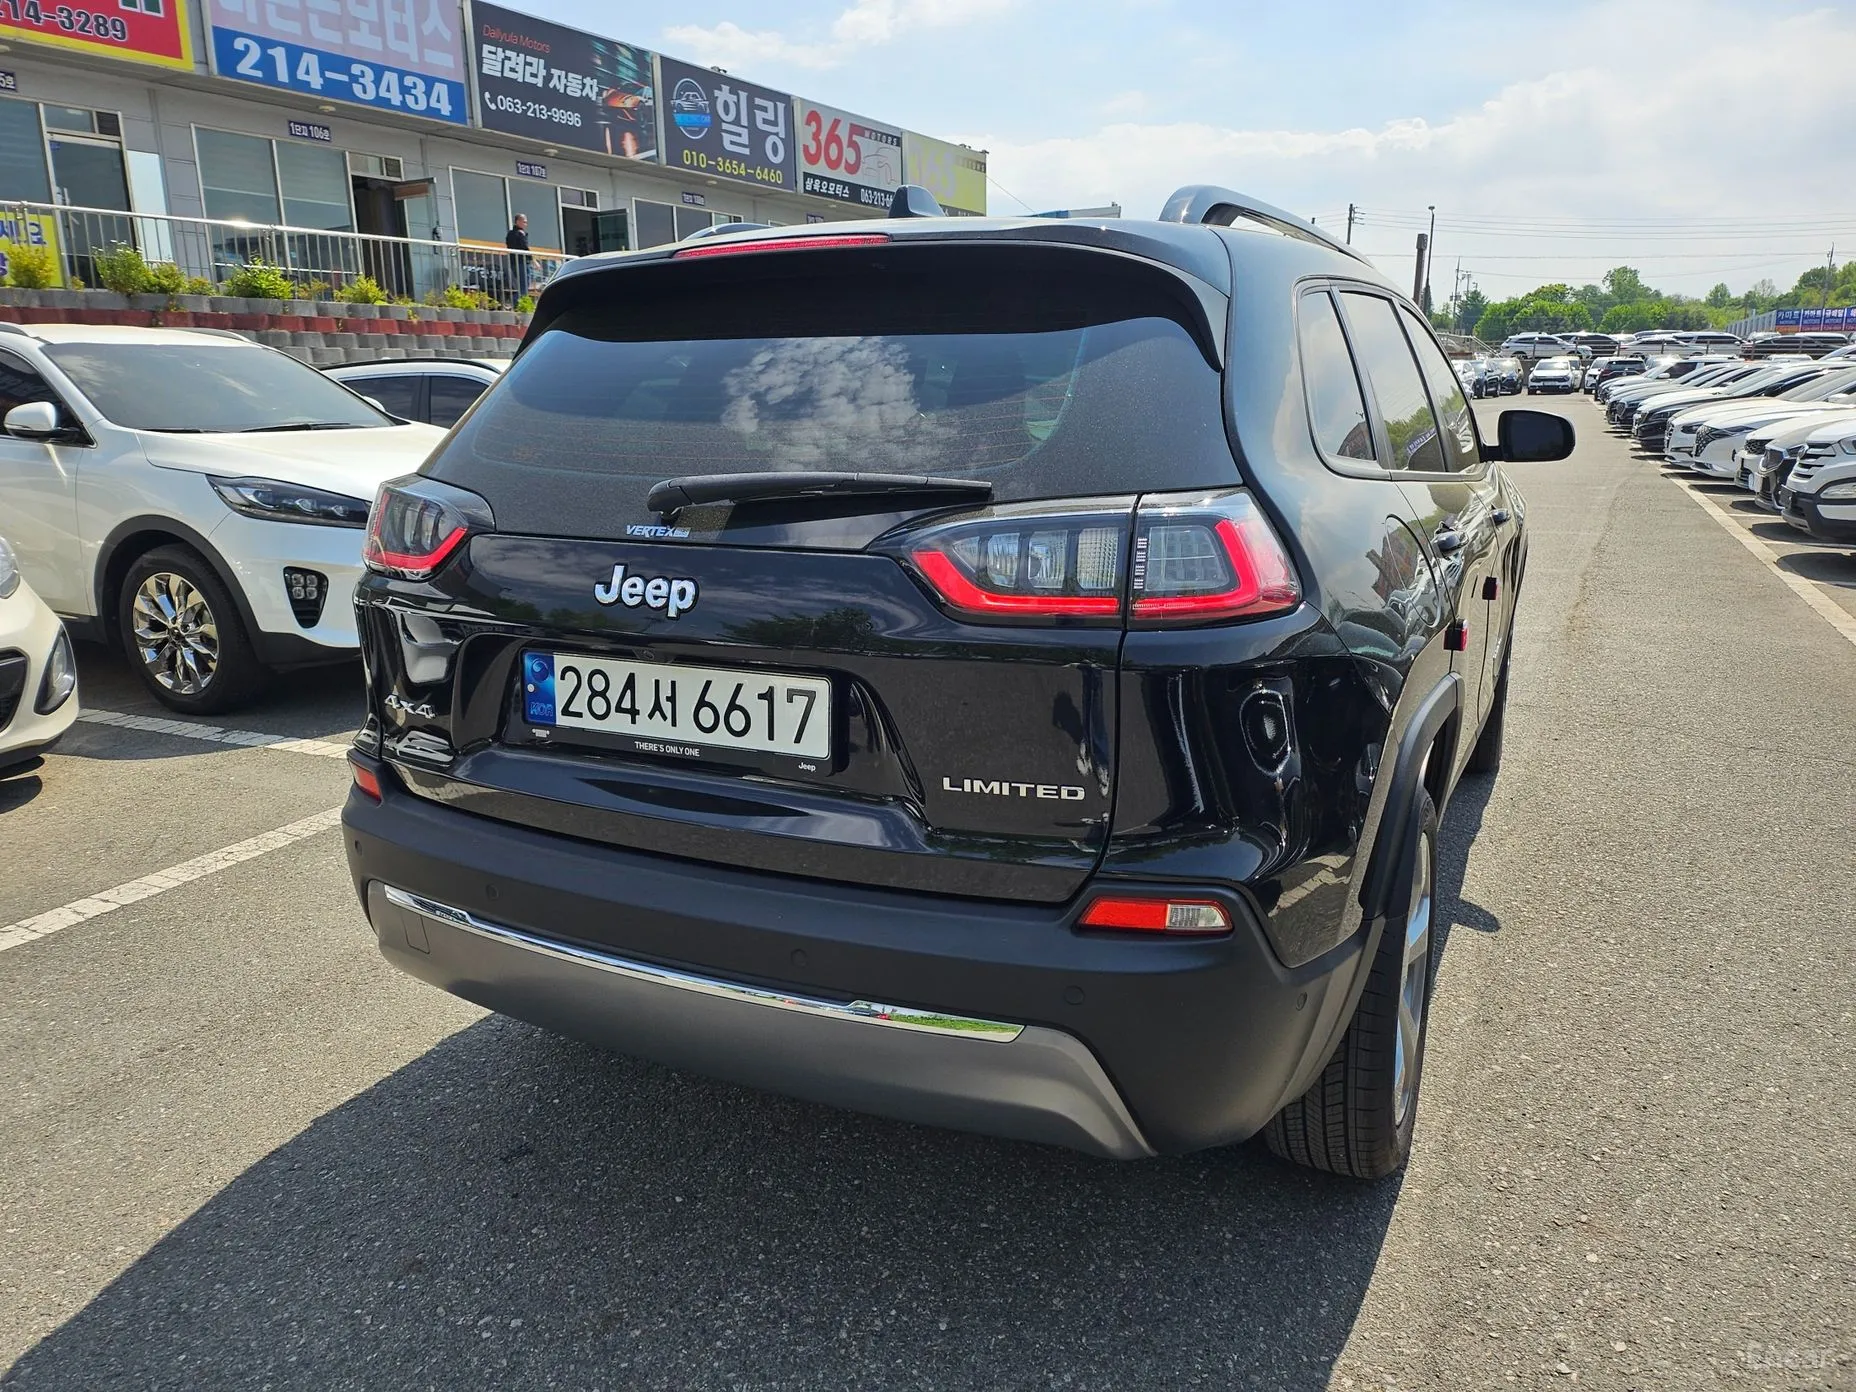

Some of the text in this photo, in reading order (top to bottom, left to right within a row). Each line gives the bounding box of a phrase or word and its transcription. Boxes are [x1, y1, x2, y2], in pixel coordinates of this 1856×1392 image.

[0, 0, 128, 41] 14-3289
[520, 34, 551, 54] Motors
[232, 37, 453, 116] 214-3434
[481, 44, 599, 101] 달려라 자동차
[497, 95, 582, 128] 063-213-9996
[714, 84, 785, 164] 힐링
[309, 125, 331, 140] 106호
[803, 110, 861, 175] 365
[683, 149, 783, 184] 010-3654-6460
[805, 177, 850, 198] 삼육오모터스
[626, 525, 675, 538] VERTEX
[594, 565, 696, 618] Jeep
[559, 665, 817, 744] 284서 6617
[634, 741, 700, 757] THERE'S ONLY ONE
[798, 761, 817, 772] Jeep
[942, 777, 1086, 801] LIMITED
